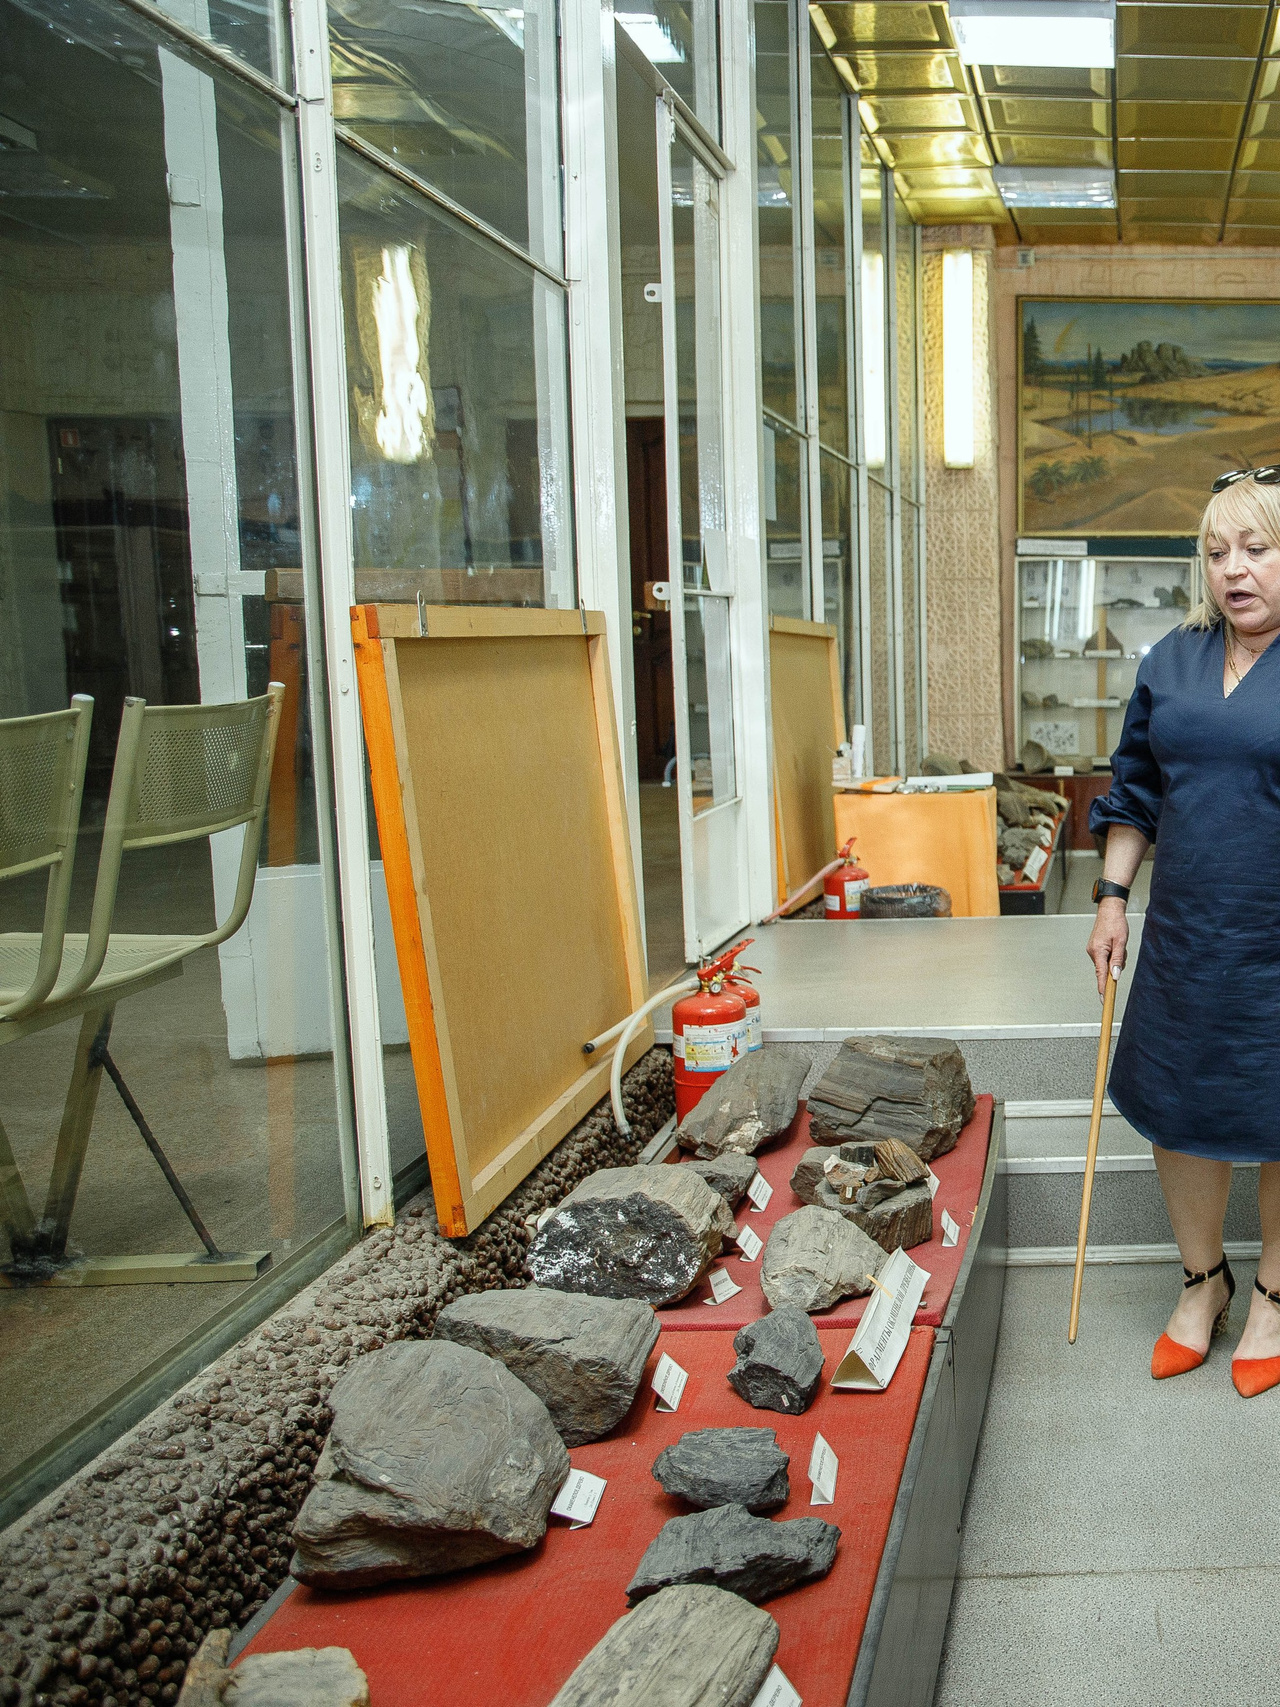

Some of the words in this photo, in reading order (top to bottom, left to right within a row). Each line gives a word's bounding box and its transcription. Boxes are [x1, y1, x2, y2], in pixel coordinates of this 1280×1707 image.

[868, 1323, 892, 1371] ФРАГМЕНТЫ
[887, 1289, 905, 1331] ОКАМЕНЕЛОЙ
[898, 1261, 917, 1295] ДРЕВЕСИНЫ
[768, 1684, 783, 1707] ДЕРЕВО
